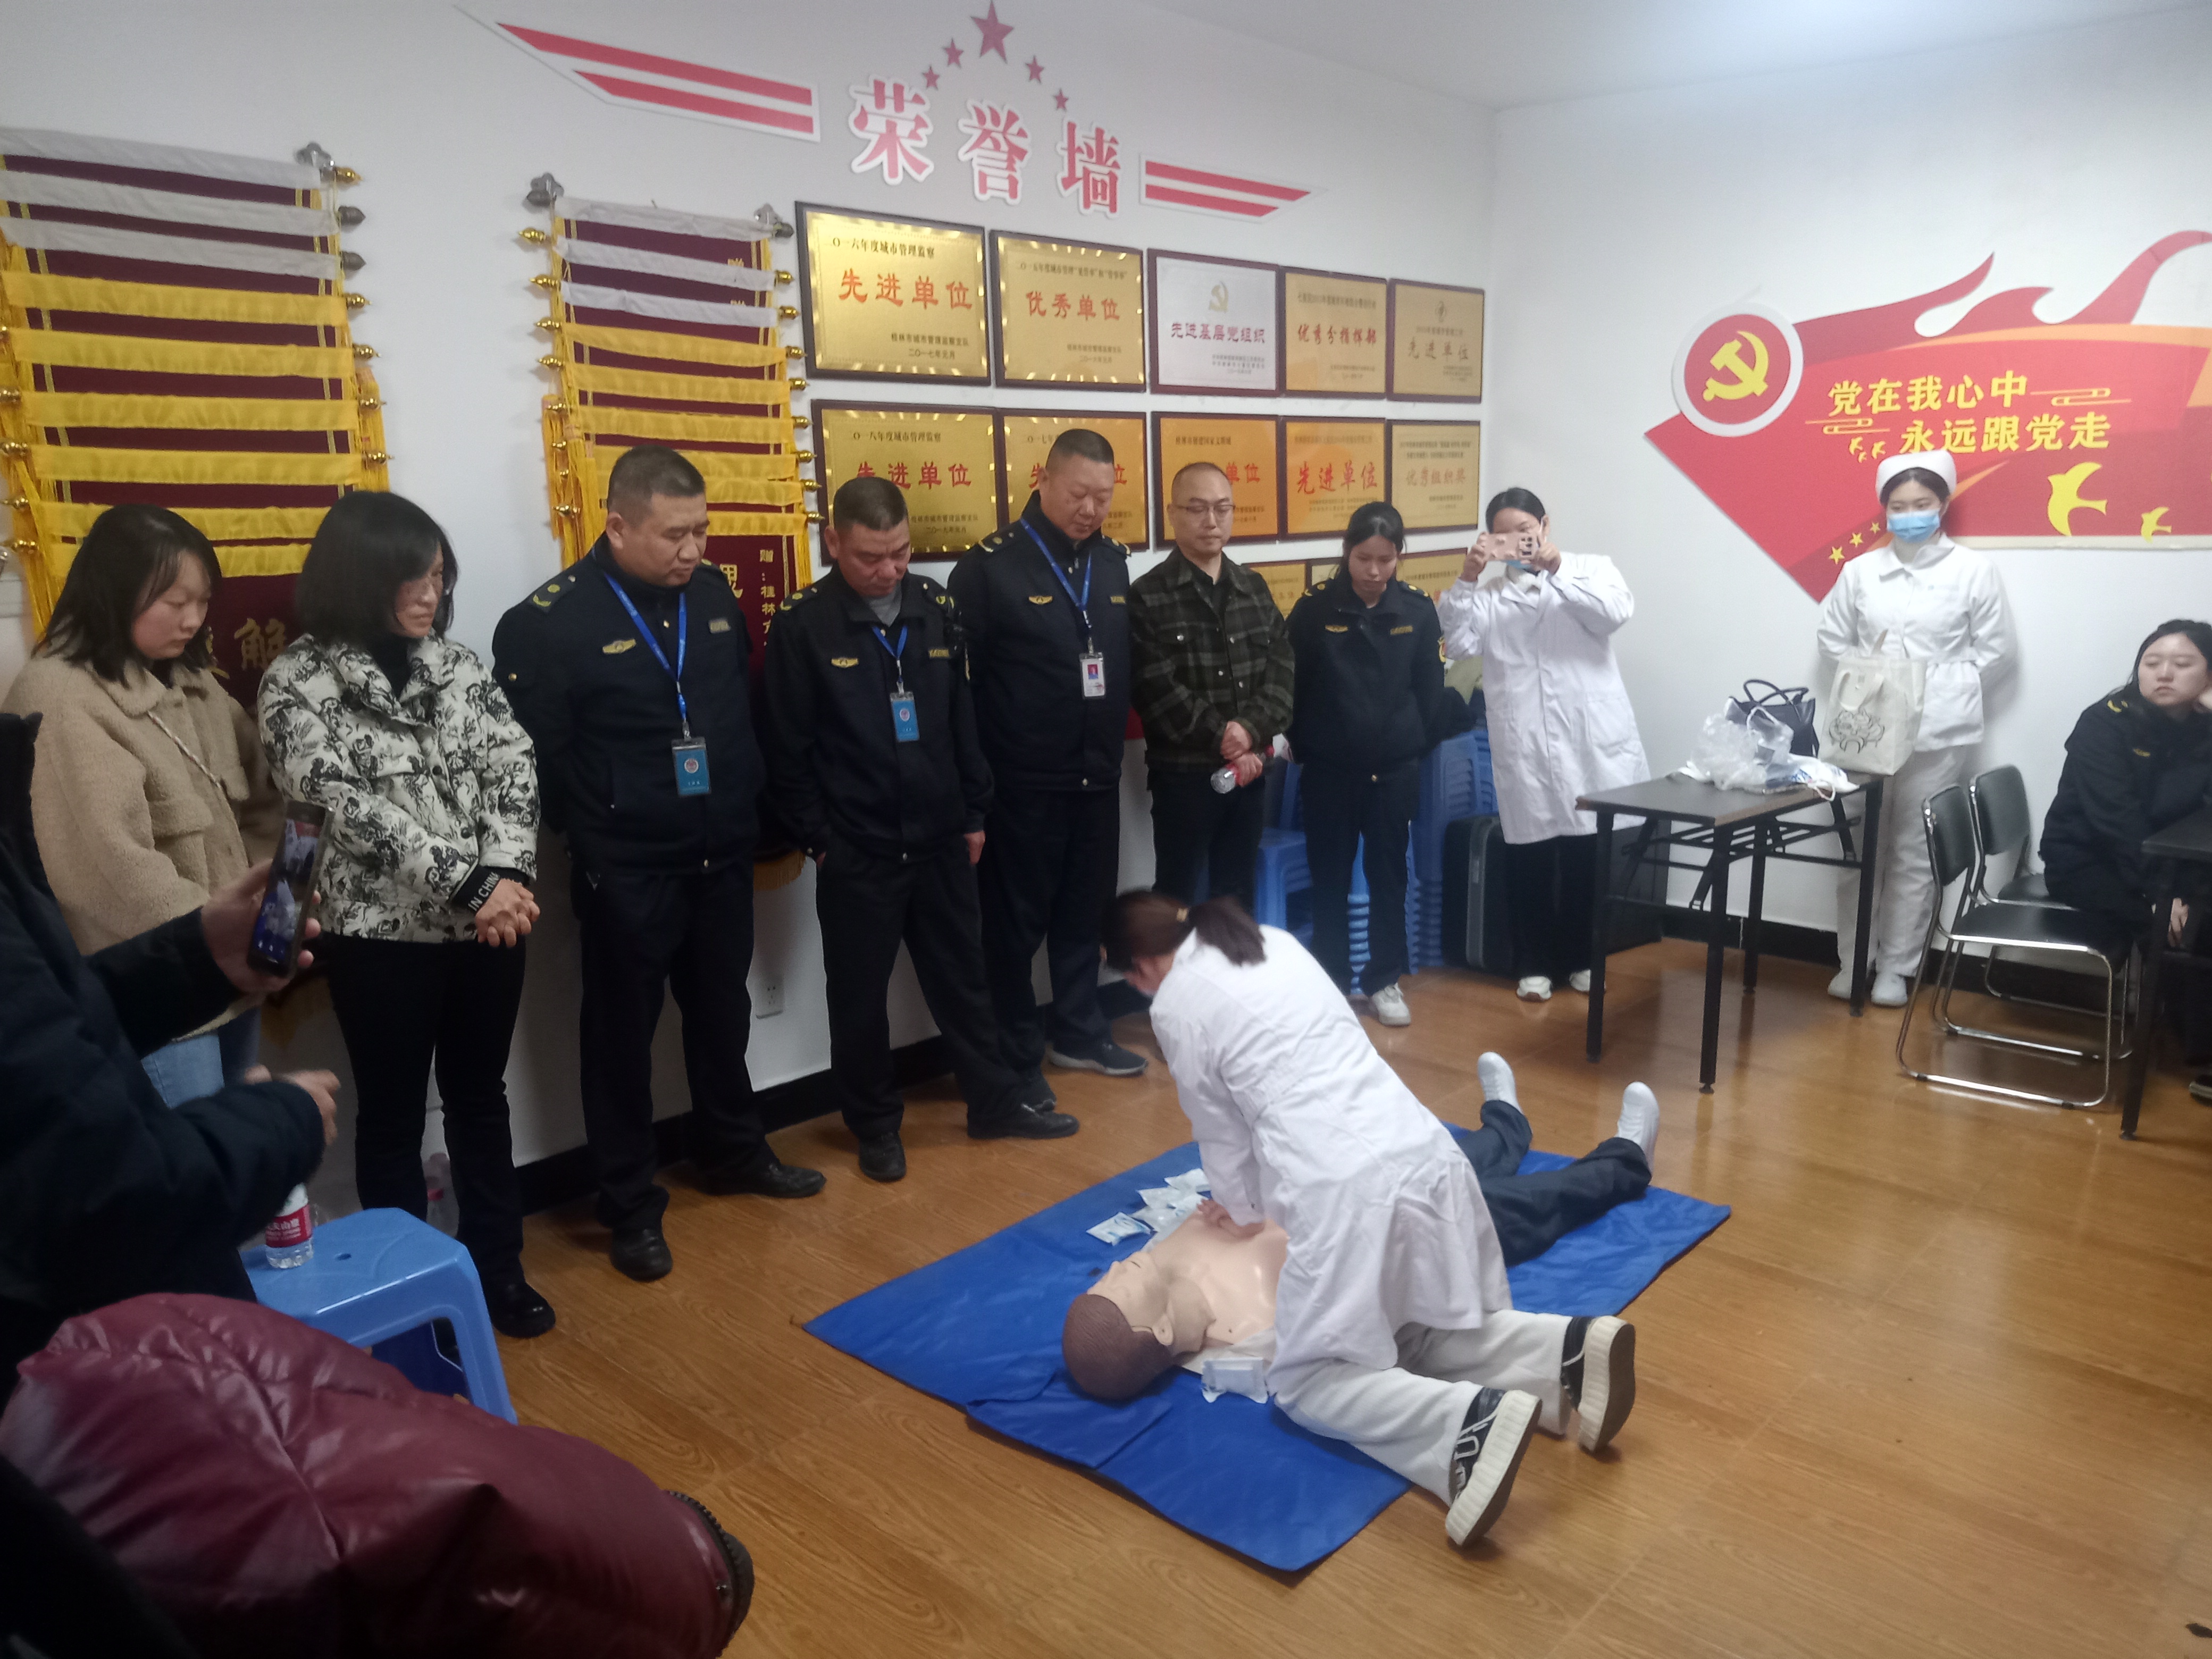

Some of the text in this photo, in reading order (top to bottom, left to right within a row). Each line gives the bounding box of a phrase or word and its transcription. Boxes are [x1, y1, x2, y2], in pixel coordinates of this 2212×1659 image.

[850, 78, 1121, 214] 荣誉墙
[839, 267, 973, 309] 先进单位
[1026, 291, 1120, 321] 优秀单位
[1171, 322, 1266, 343] 先进基层党组织
[1409, 336, 1469, 361] 先进单位
[1828, 370, 2028, 417] 党在我心中
[1899, 412, 2112, 454] 永远跟党走
[1297, 460, 1378, 495] 先进单位
[467, 896, 483, 911] IN
